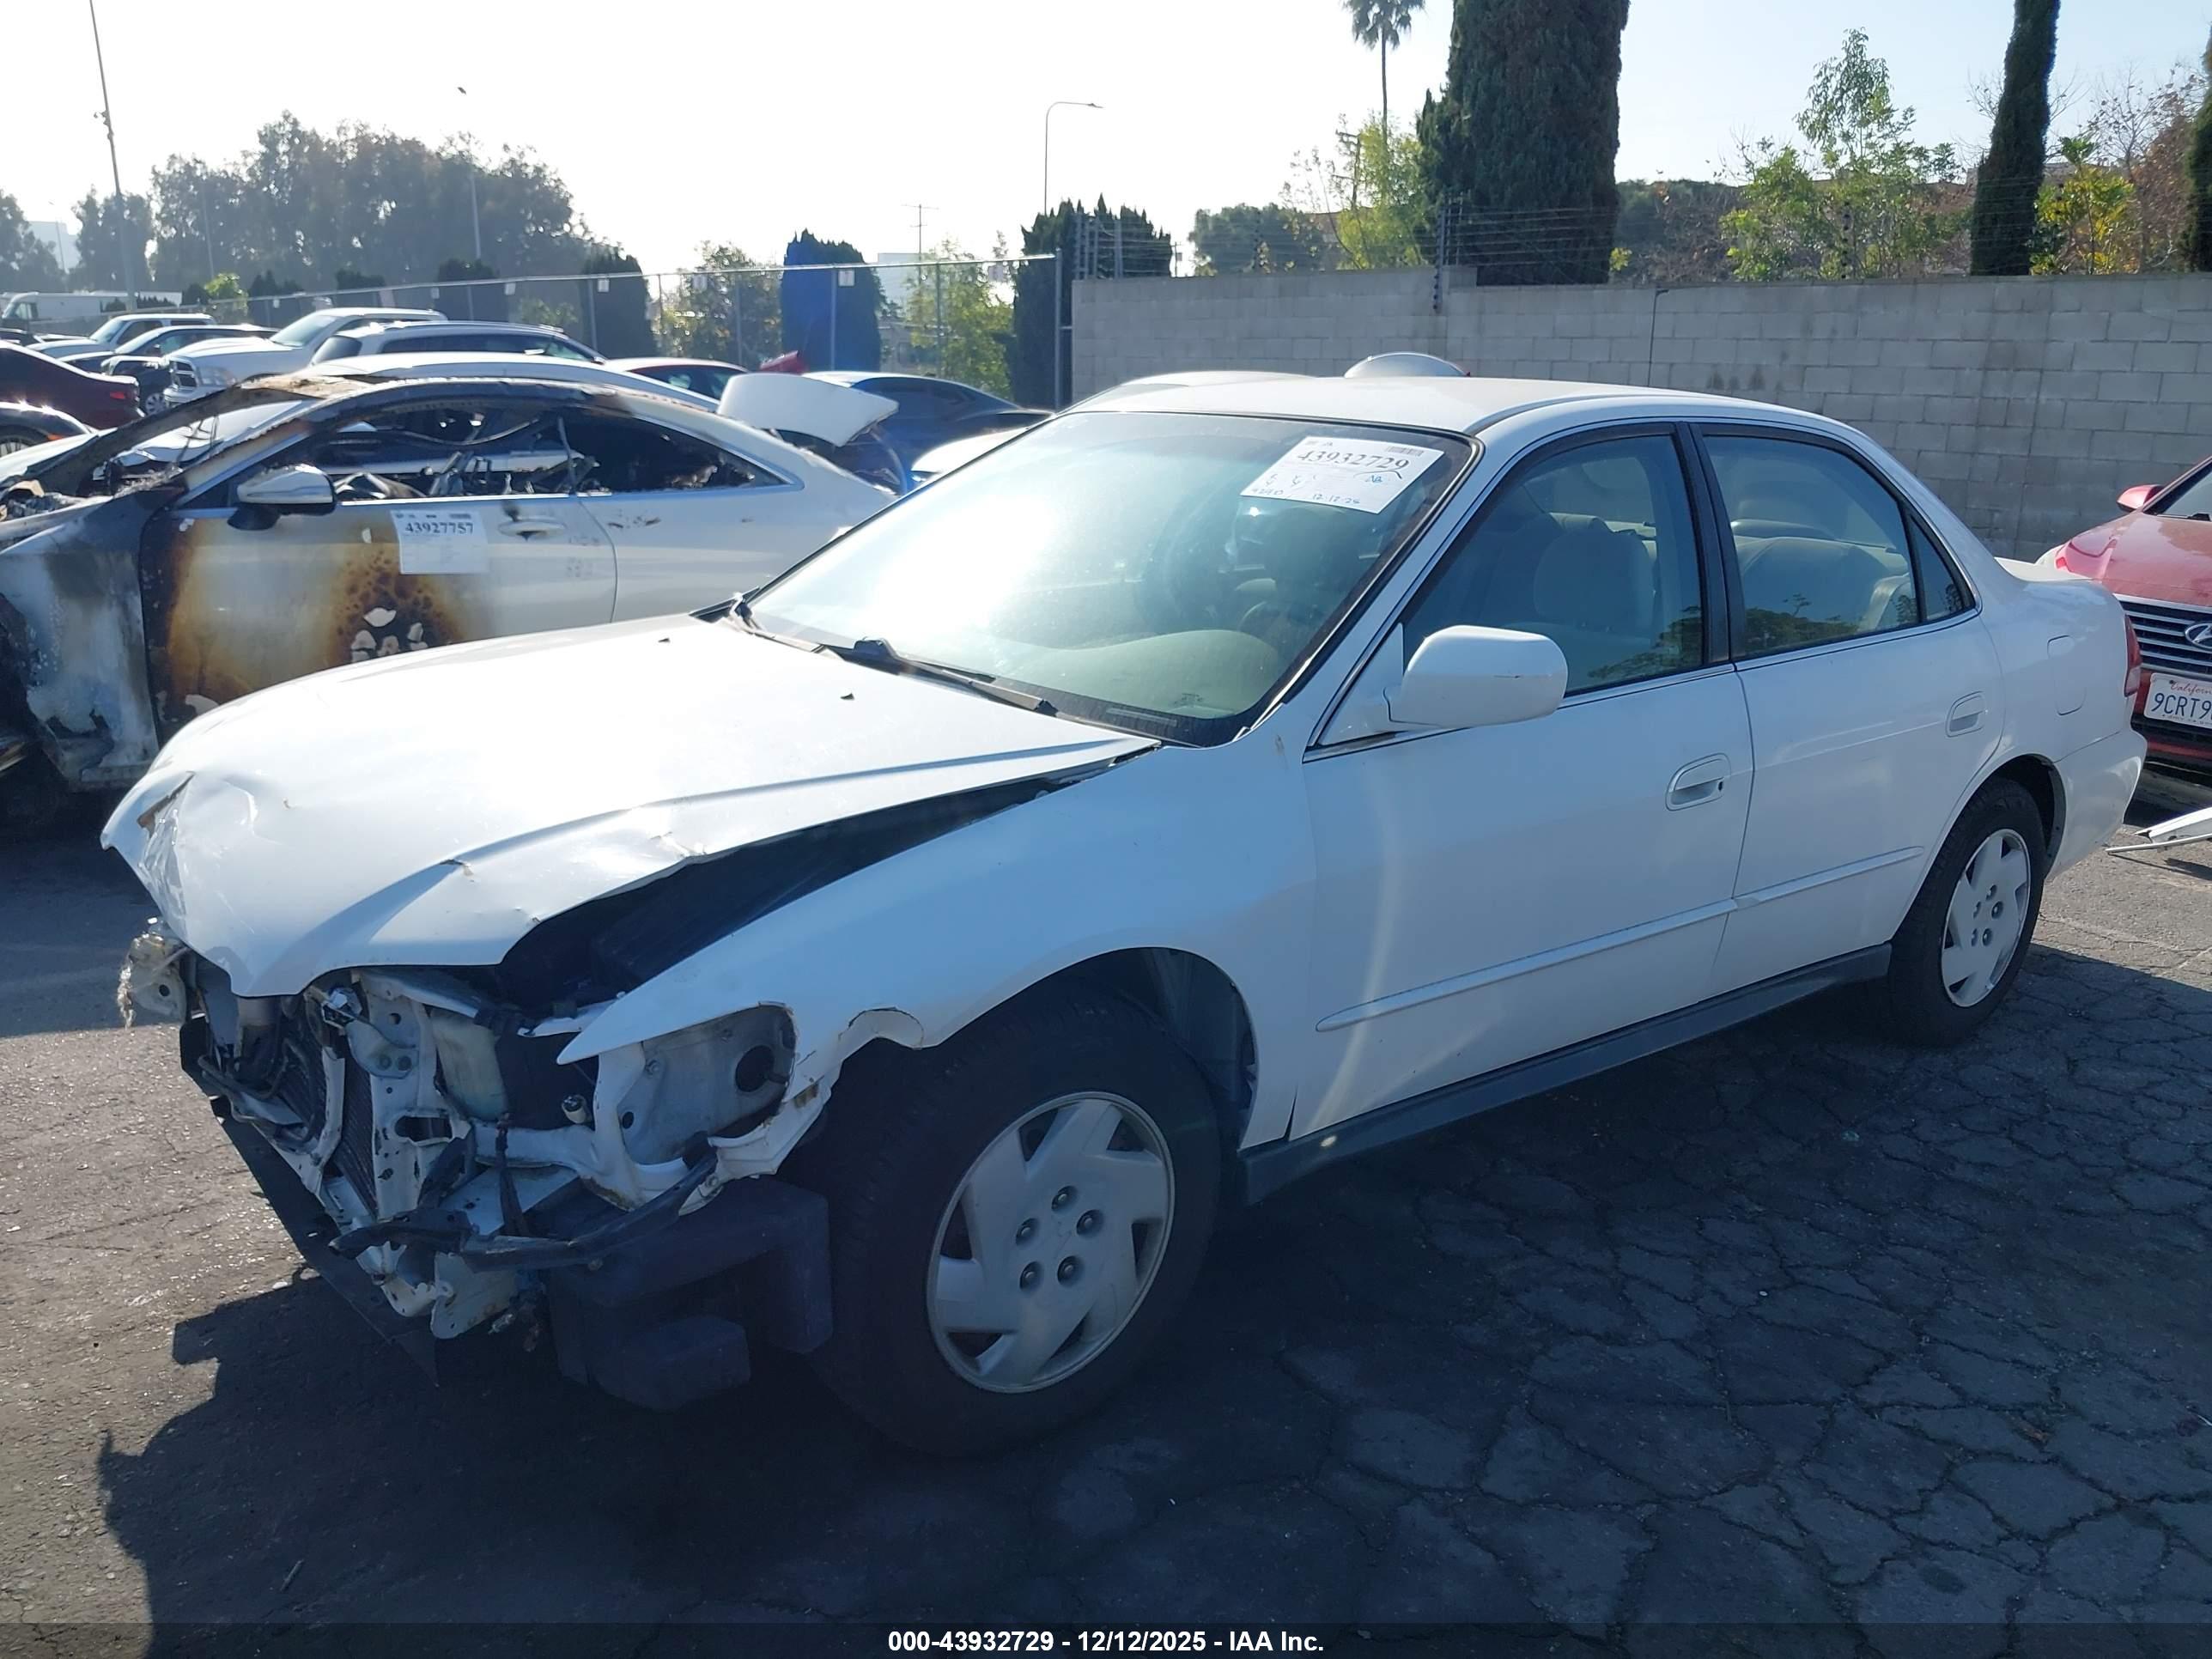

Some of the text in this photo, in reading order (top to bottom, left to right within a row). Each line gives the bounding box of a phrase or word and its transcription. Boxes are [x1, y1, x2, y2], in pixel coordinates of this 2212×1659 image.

[1297, 449, 1410, 469] 43932729
[405, 521, 474, 534] 43927757
[2150, 692, 2212, 720] 9CRT9
